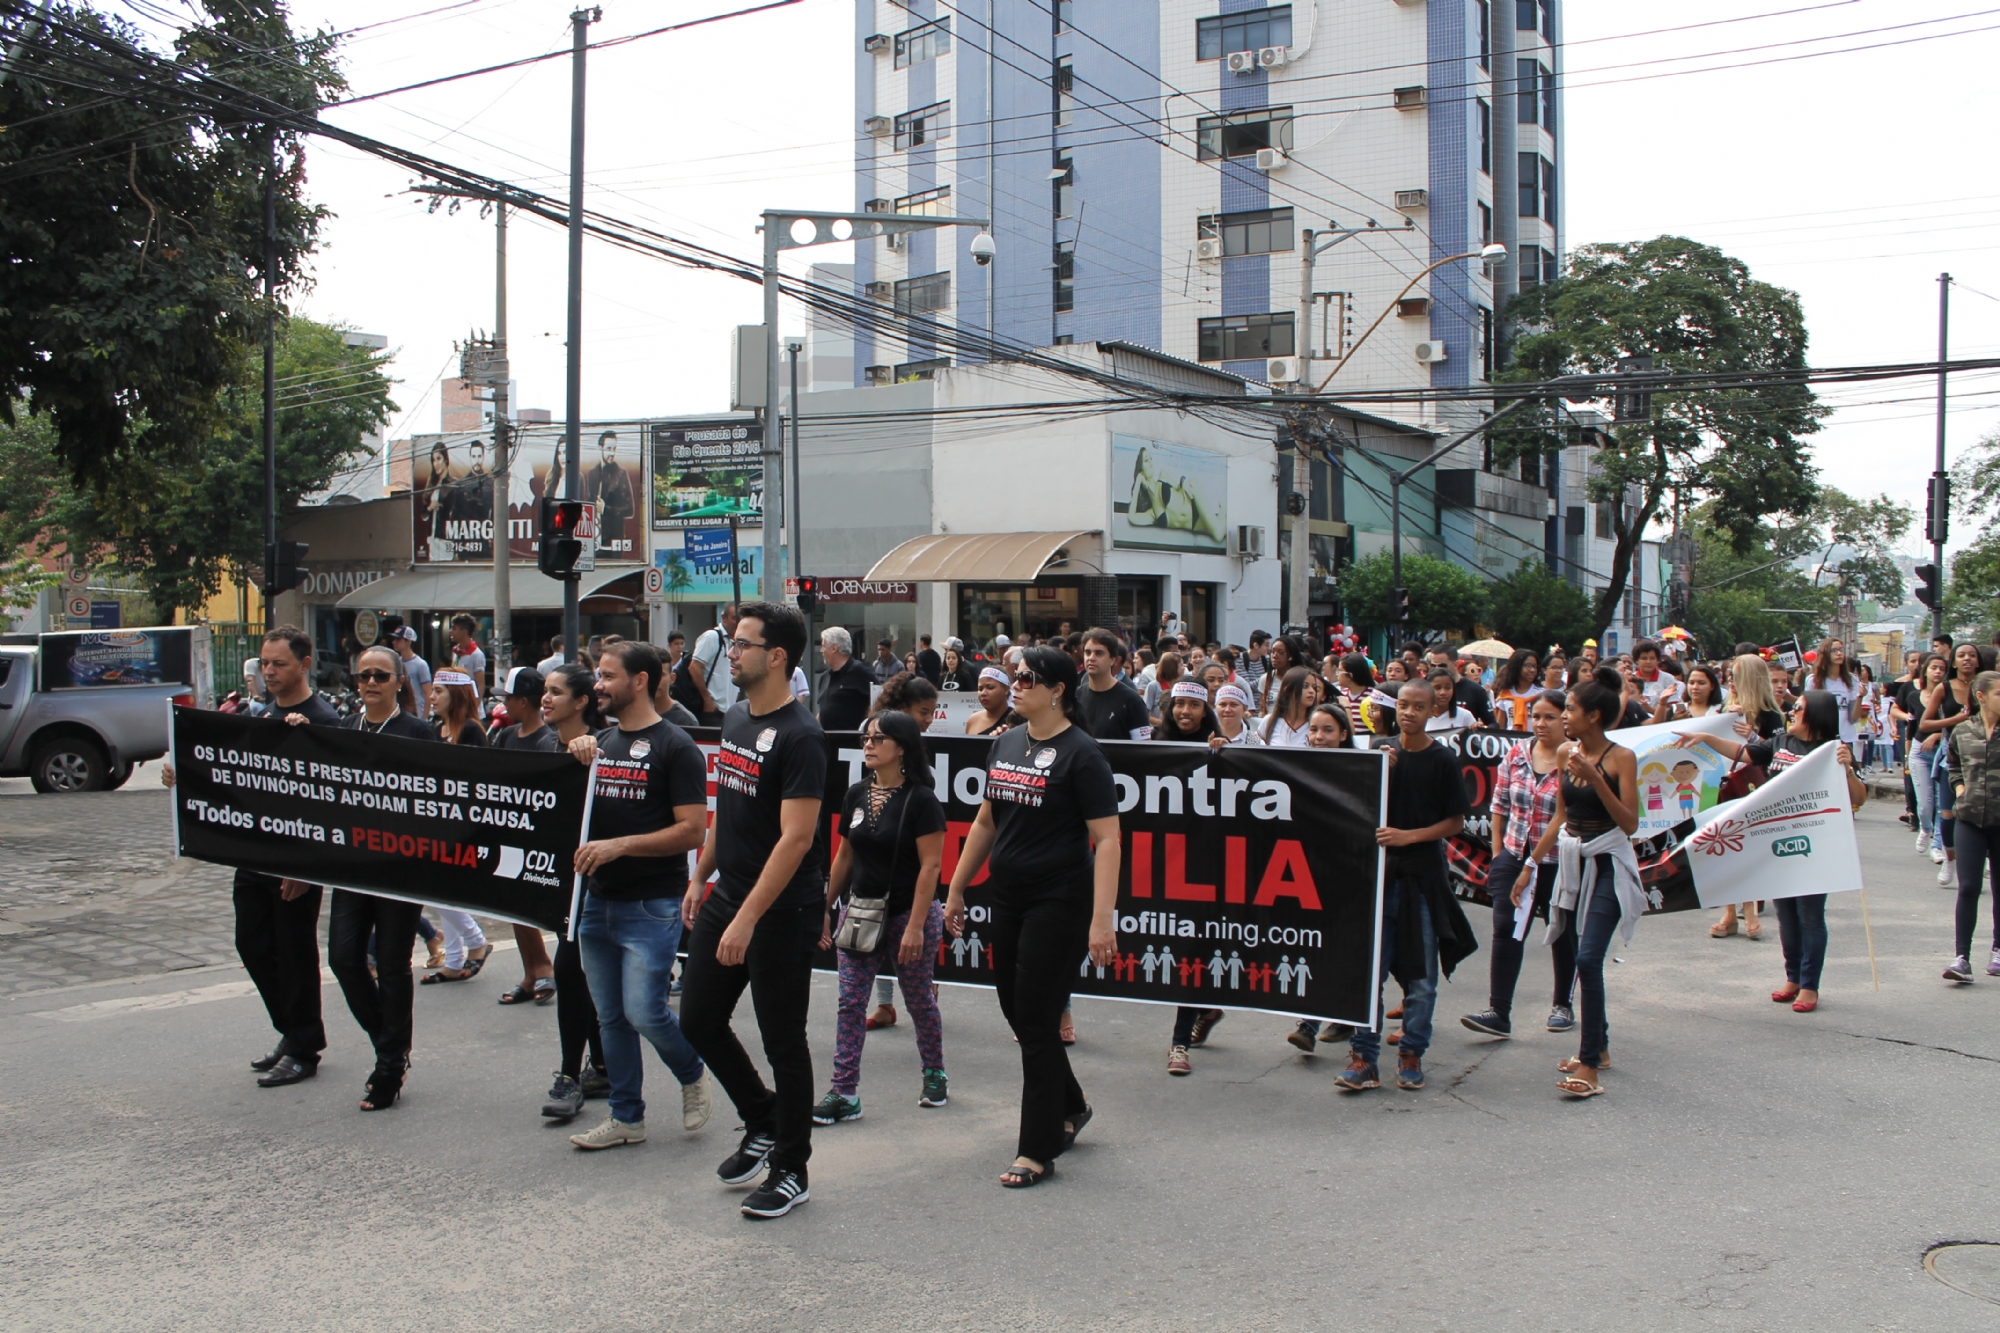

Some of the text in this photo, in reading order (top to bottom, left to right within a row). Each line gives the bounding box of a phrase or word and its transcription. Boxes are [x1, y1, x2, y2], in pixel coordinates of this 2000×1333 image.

[685, 425, 747, 442] Pousada do
[673, 440, 760, 458] Rio Quente 2018
[445, 519, 532, 540] MARGTTI
[689, 518, 700, 526] SEU
[702, 518, 720, 526] LUGAR
[710, 542, 728, 550] Janeiro
[651, 574, 656, 586] E
[76, 602, 82, 611] E
[615, 759, 641, 768] contra
[643, 762, 650, 770] a
[758, 755, 764, 763] a
[596, 766, 648, 781] EDOFILIA
[996, 760, 1050, 777] Todos contra a
[194, 744, 557, 812] OS LOJISTAS E PRESTADORES DE SERVIÇO
[989, 769, 1046, 788] PEDOFILIA
[212, 768, 535, 831] DE DIVINÓPOLIS APOIAM ESTA CAUSA.
[1112, 764, 1292, 821] ontra
[1745, 790, 1829, 819] CONSELHO DA MULHER
[1746, 802, 1818, 824] EMPREENDEDORA
[260, 815, 325, 842] contra
[332, 828, 346, 845] a
[1750, 825, 1786, 837] DIVINÓPOLIS
[1792, 822, 1808, 830] MINAS
[1777, 838, 1808, 854] ACID
[525, 850, 556, 873] CDL
[523, 872, 560, 887] Divinópolis
